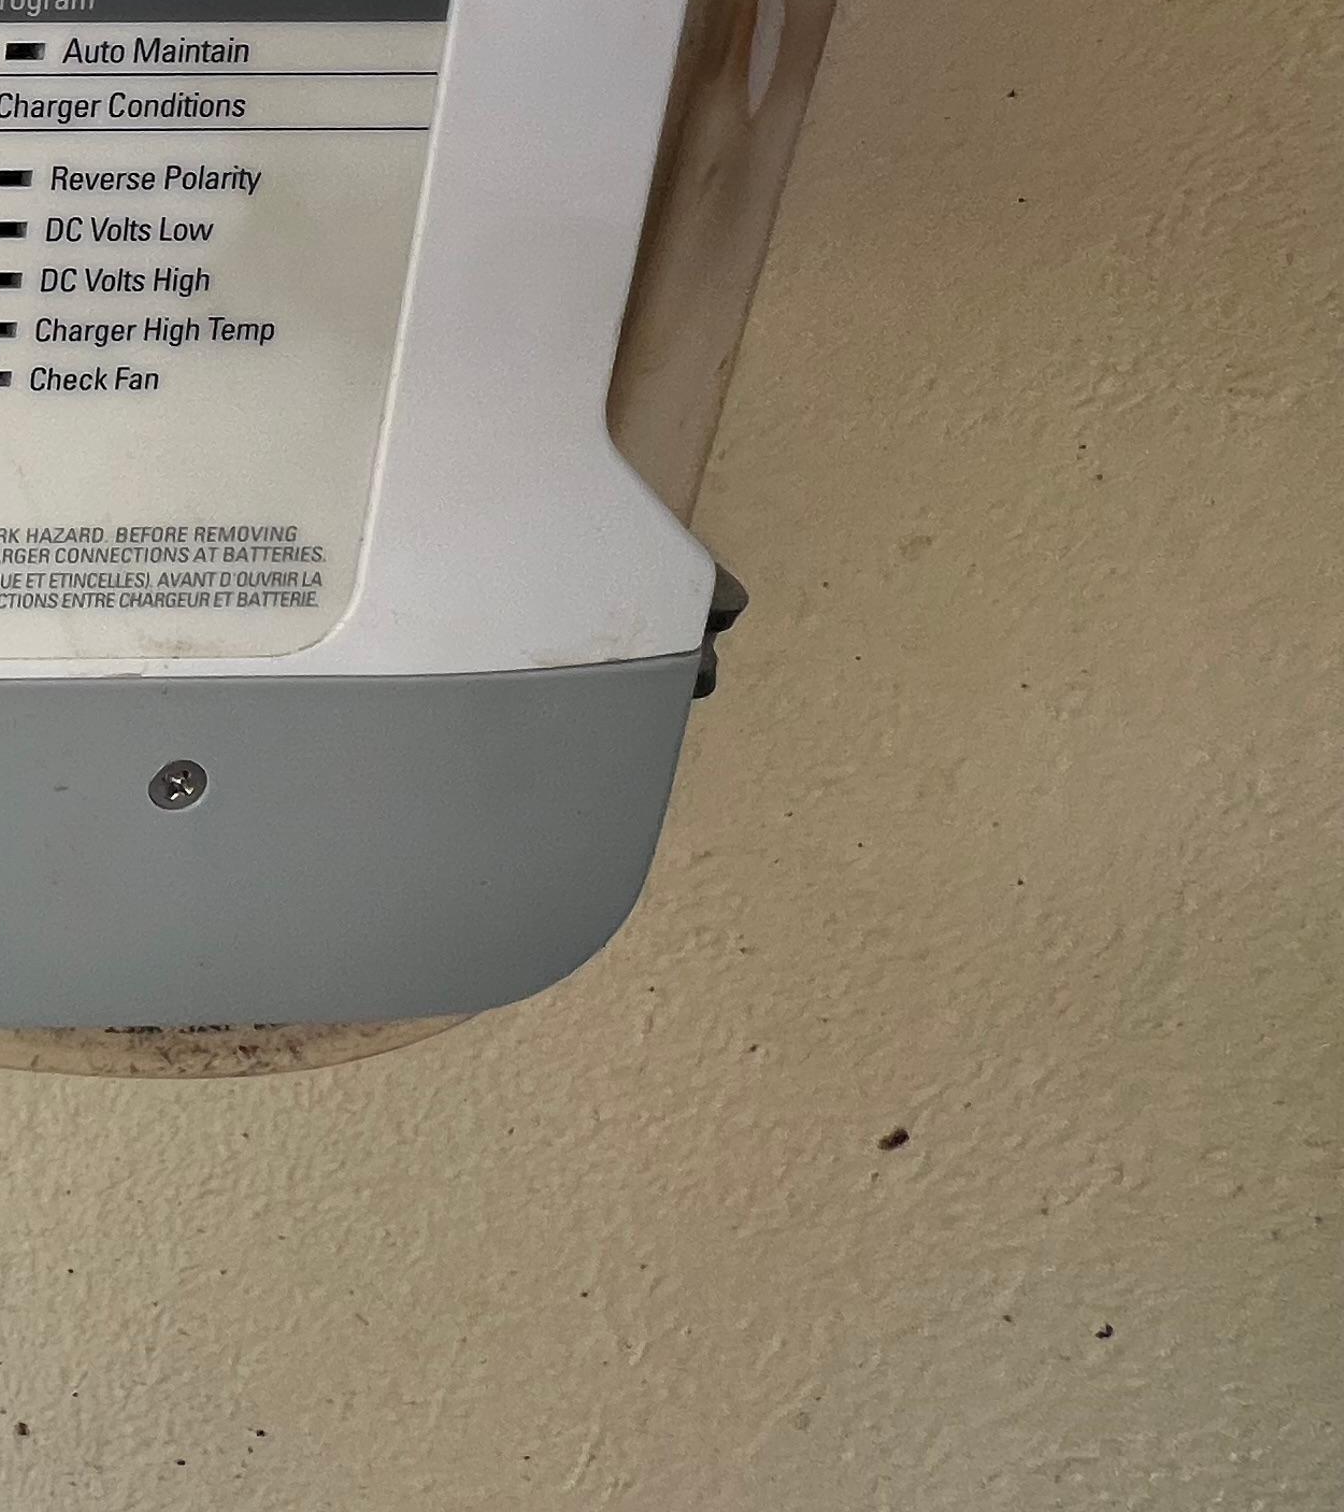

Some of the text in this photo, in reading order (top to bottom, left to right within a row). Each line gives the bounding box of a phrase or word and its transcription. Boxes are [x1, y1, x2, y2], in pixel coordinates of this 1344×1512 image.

[61, 37, 250, 64] Auto Maintain
[108, 92, 246, 118] Conditions
[50, 164, 262, 196] Reverse Polarity
[45, 216, 215, 243] DC Volts Low
[40, 267, 210, 297] DC Volts High
[35, 316, 275, 348] Charger High Temp
[30, 366, 159, 392] Check Fan
[114, 525, 189, 545] BEFORE
[193, 525, 299, 544] REMOVING
[54, 545, 192, 564] CONNECTIONS
[191, 546, 219, 563] AT
[222, 545, 327, 564] BATTERIES.
